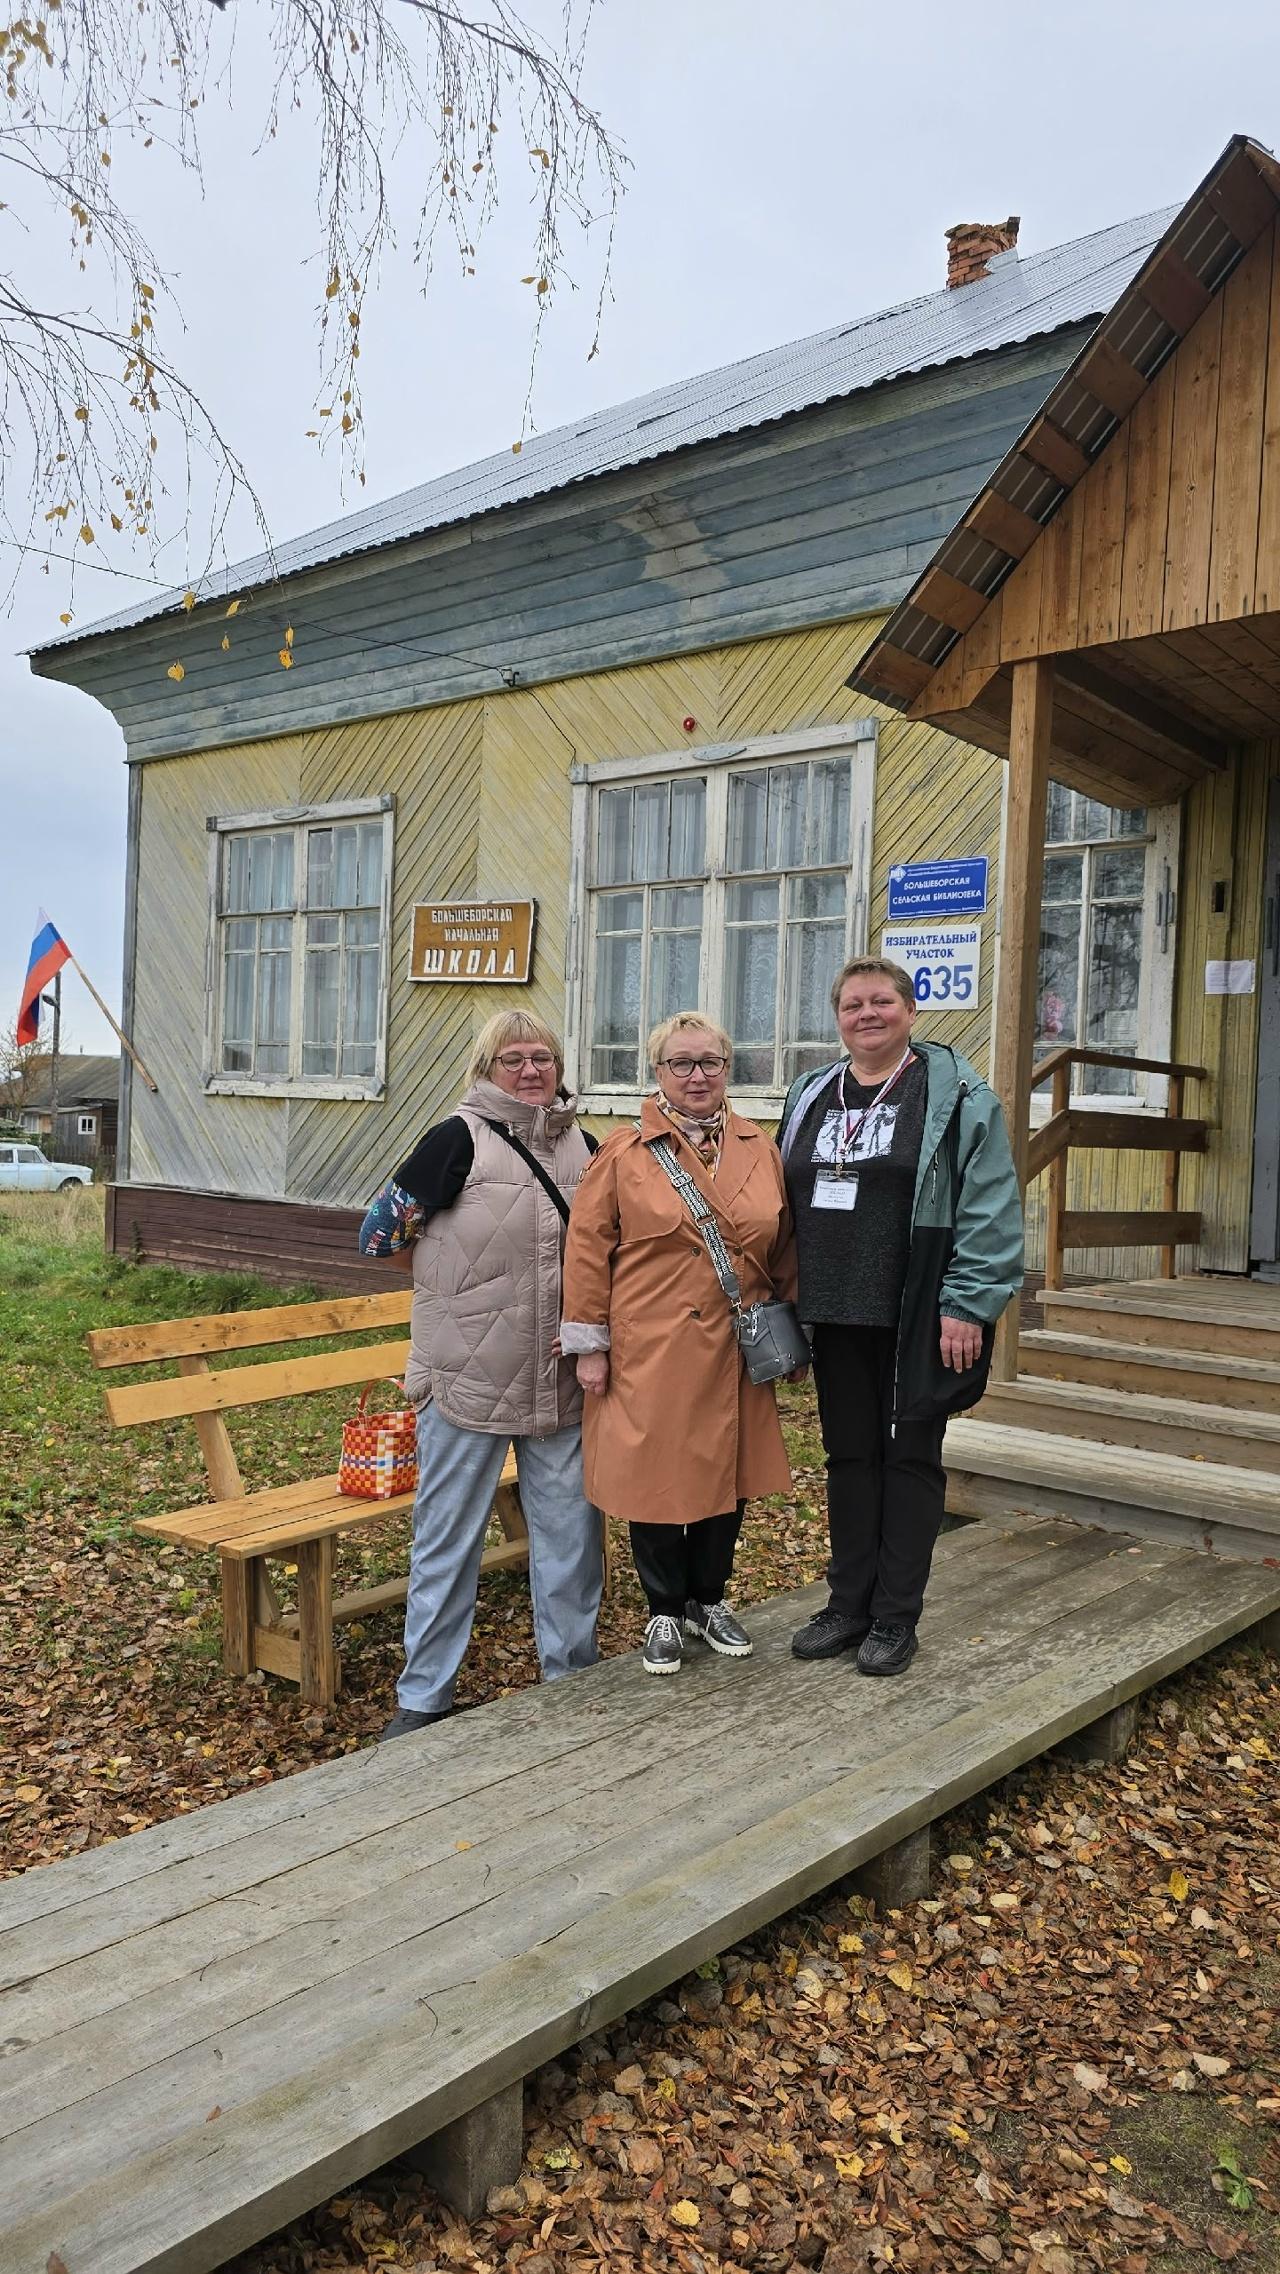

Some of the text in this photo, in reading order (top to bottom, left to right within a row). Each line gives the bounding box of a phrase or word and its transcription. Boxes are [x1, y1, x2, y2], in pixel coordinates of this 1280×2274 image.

[903, 877, 971, 891] БОЛЬШЕБОРСКАЯ
[892, 889, 982, 905] СЕЛЬСКАЯ БИБЛИОТЕКА
[431, 908, 513, 923] БОЛЬШЕБОРСКАЯ
[444, 927, 499, 941] НАЧАЛЬНАЯ
[885, 931, 977, 946] ИЗБИРАТЕЛЬНЫЙ
[906, 948, 955, 959] УЧАСТОК
[423, 949, 514, 974] ШКОЛА
